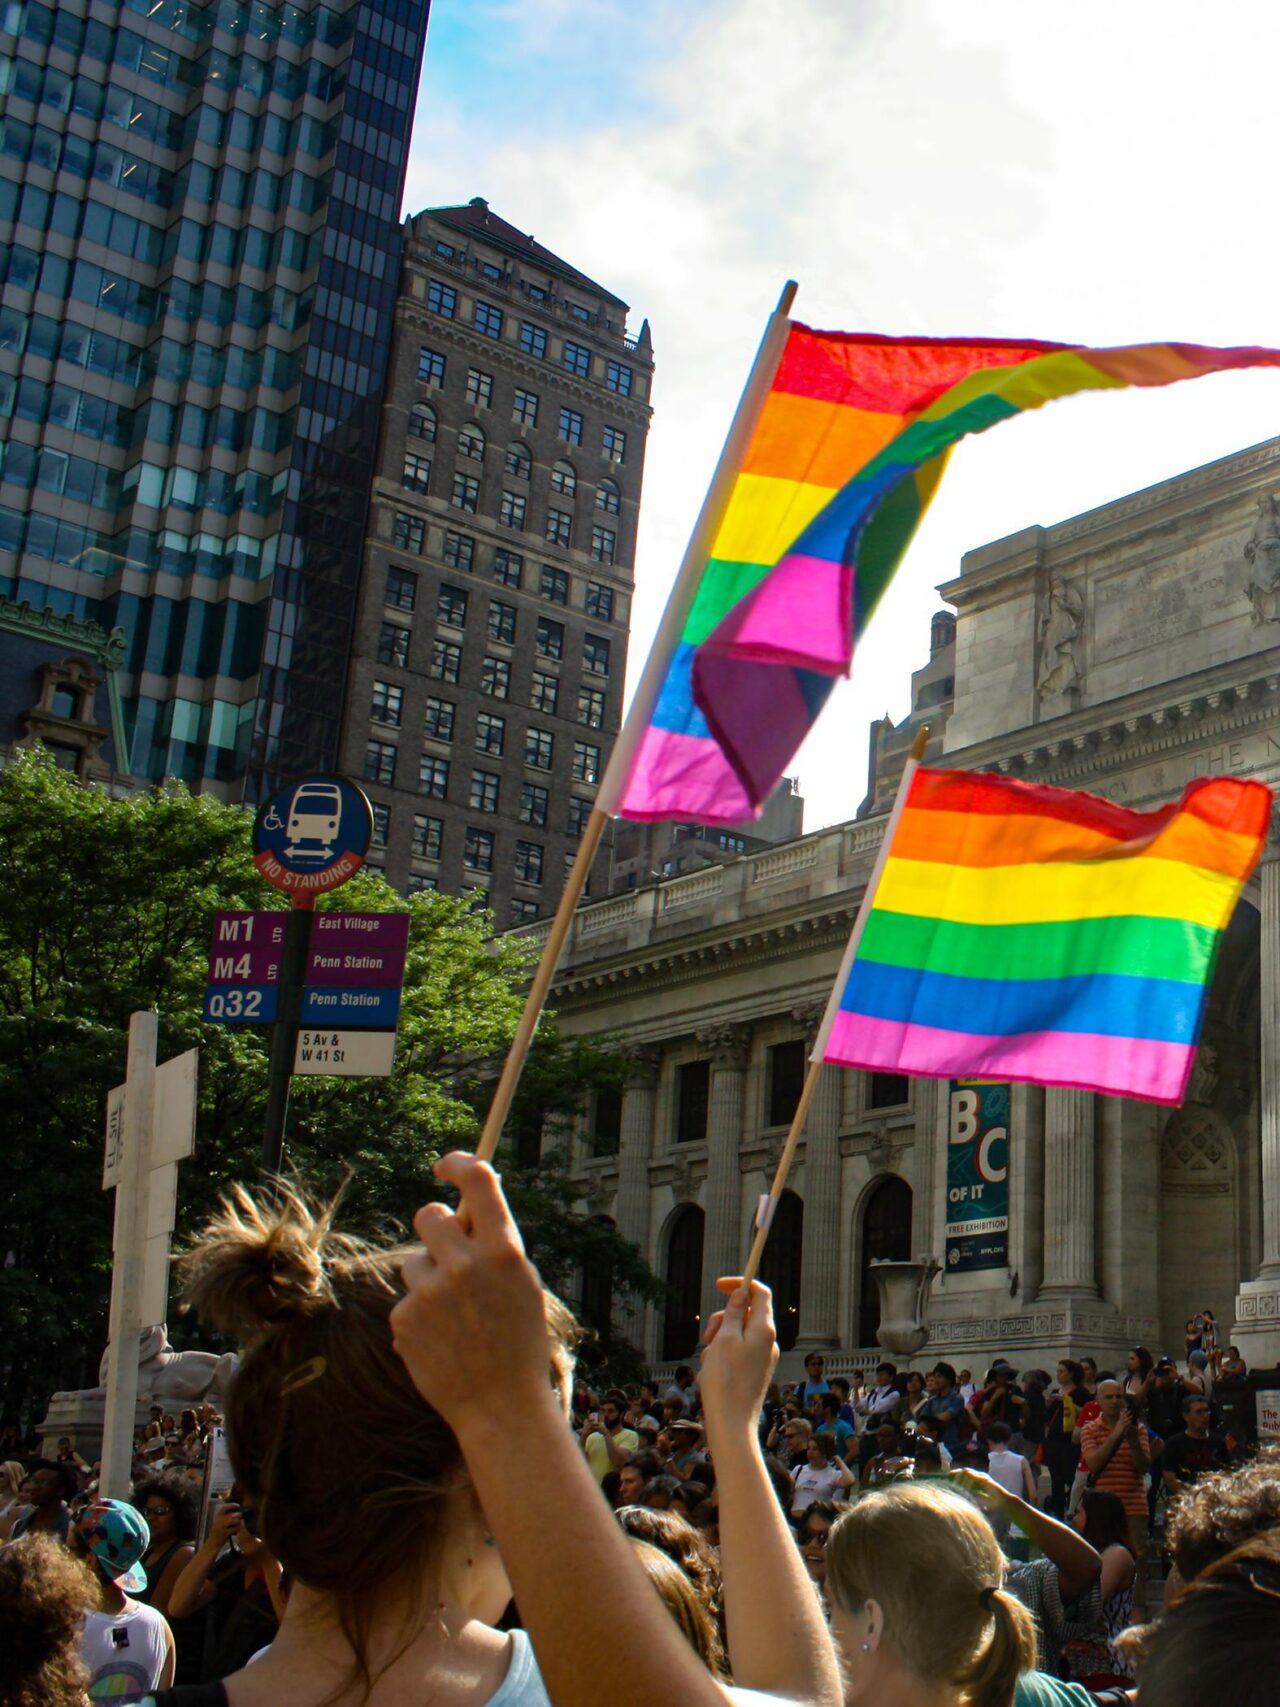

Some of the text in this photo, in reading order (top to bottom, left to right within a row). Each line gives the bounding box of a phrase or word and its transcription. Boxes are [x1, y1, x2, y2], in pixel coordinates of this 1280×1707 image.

[1187, 743, 1244, 777] THE
[262, 858, 352, 888] NO STANDING
[219, 917, 254, 941] M1
[319, 917, 380, 931] East Village
[272, 927, 283, 943] LTD
[214, 953, 251, 979] M4
[313, 955, 383, 969] Penn Station
[267, 964, 278, 980] LTD
[209, 990, 262, 1018] Q32
[309, 993, 380, 1006] Penn Station
[303, 1034, 339, 1046] 5 Av &
[302, 1050, 345, 1062] W 41 St
[951, 1089, 978, 1144] B
[979, 1127, 1007, 1182] C
[950, 1184, 984, 1202] OF IT
[948, 1219, 1006, 1234] FREE EXHIBITION
[1262, 1409, 1278, 1419] The
